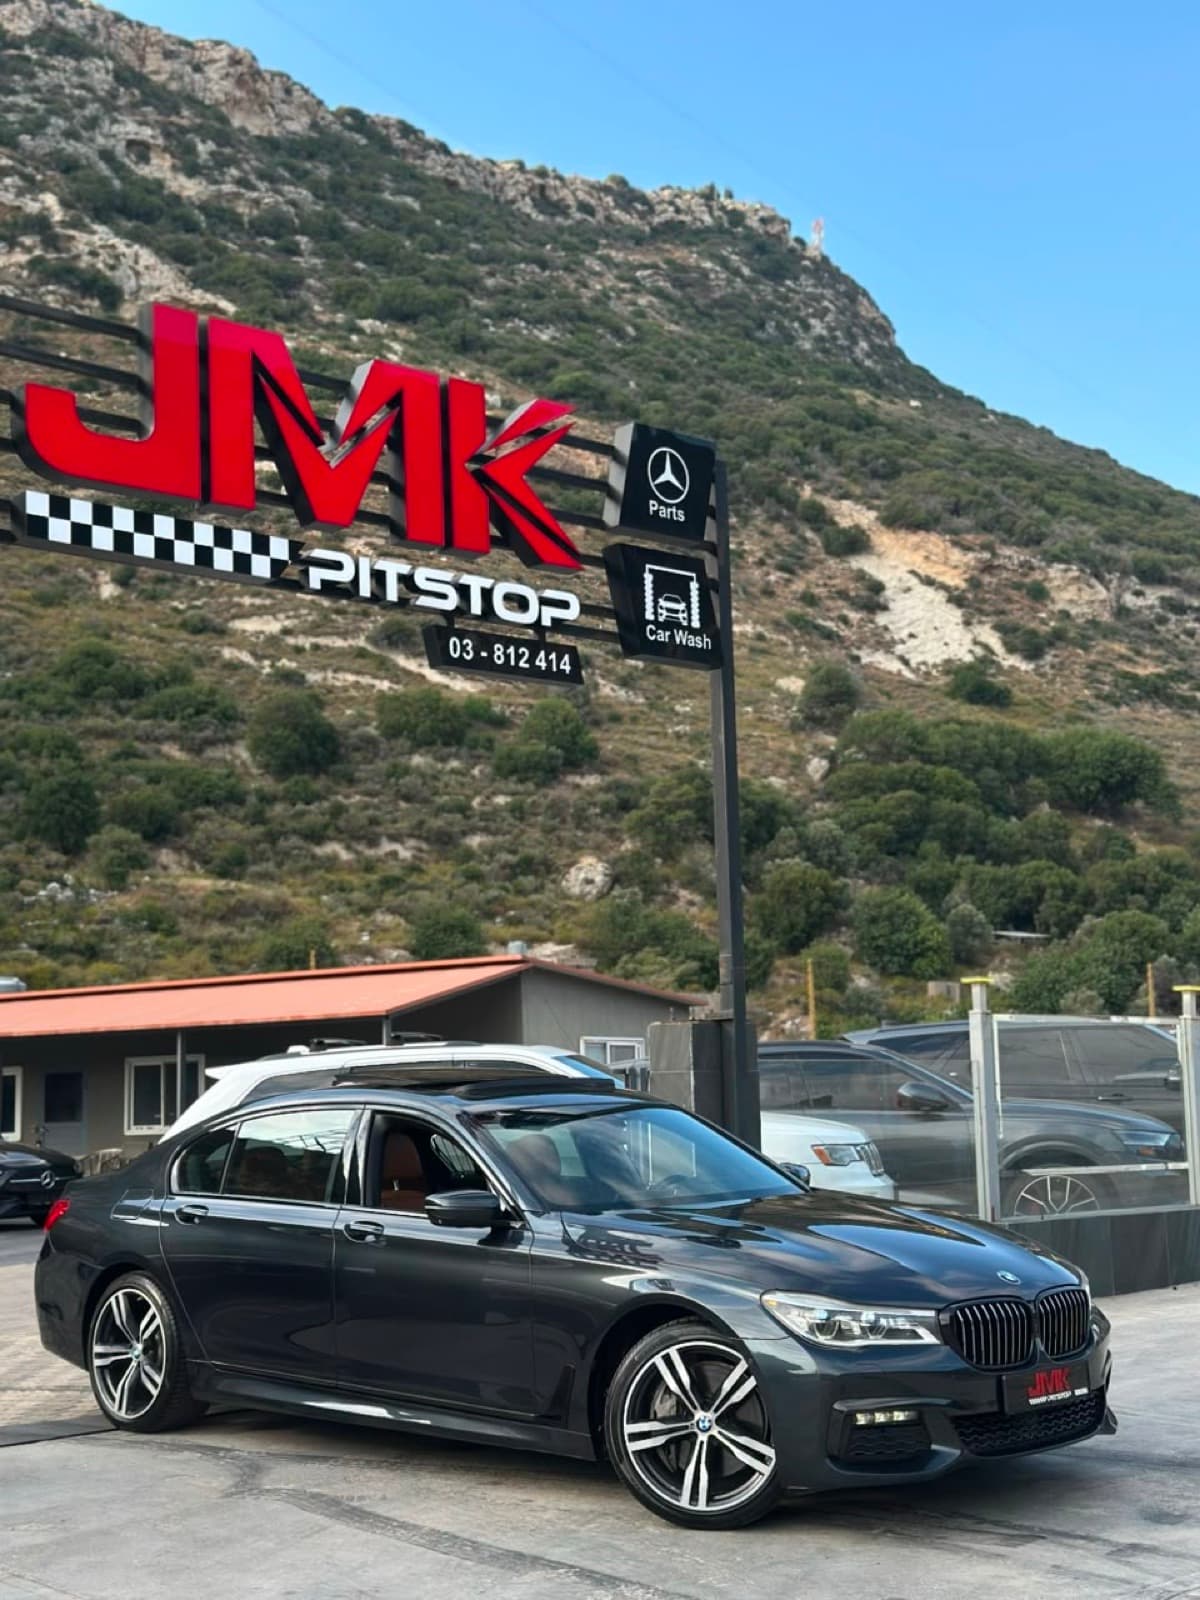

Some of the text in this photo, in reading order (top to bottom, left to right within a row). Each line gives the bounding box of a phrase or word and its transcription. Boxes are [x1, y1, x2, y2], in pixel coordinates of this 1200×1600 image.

[24, 302, 582, 570] JMK
[649, 500, 685, 522] Parts
[308, 549, 580, 627] PITSTOP
[449, 637, 474, 661] 03
[646, 624, 712, 650] Car Wash
